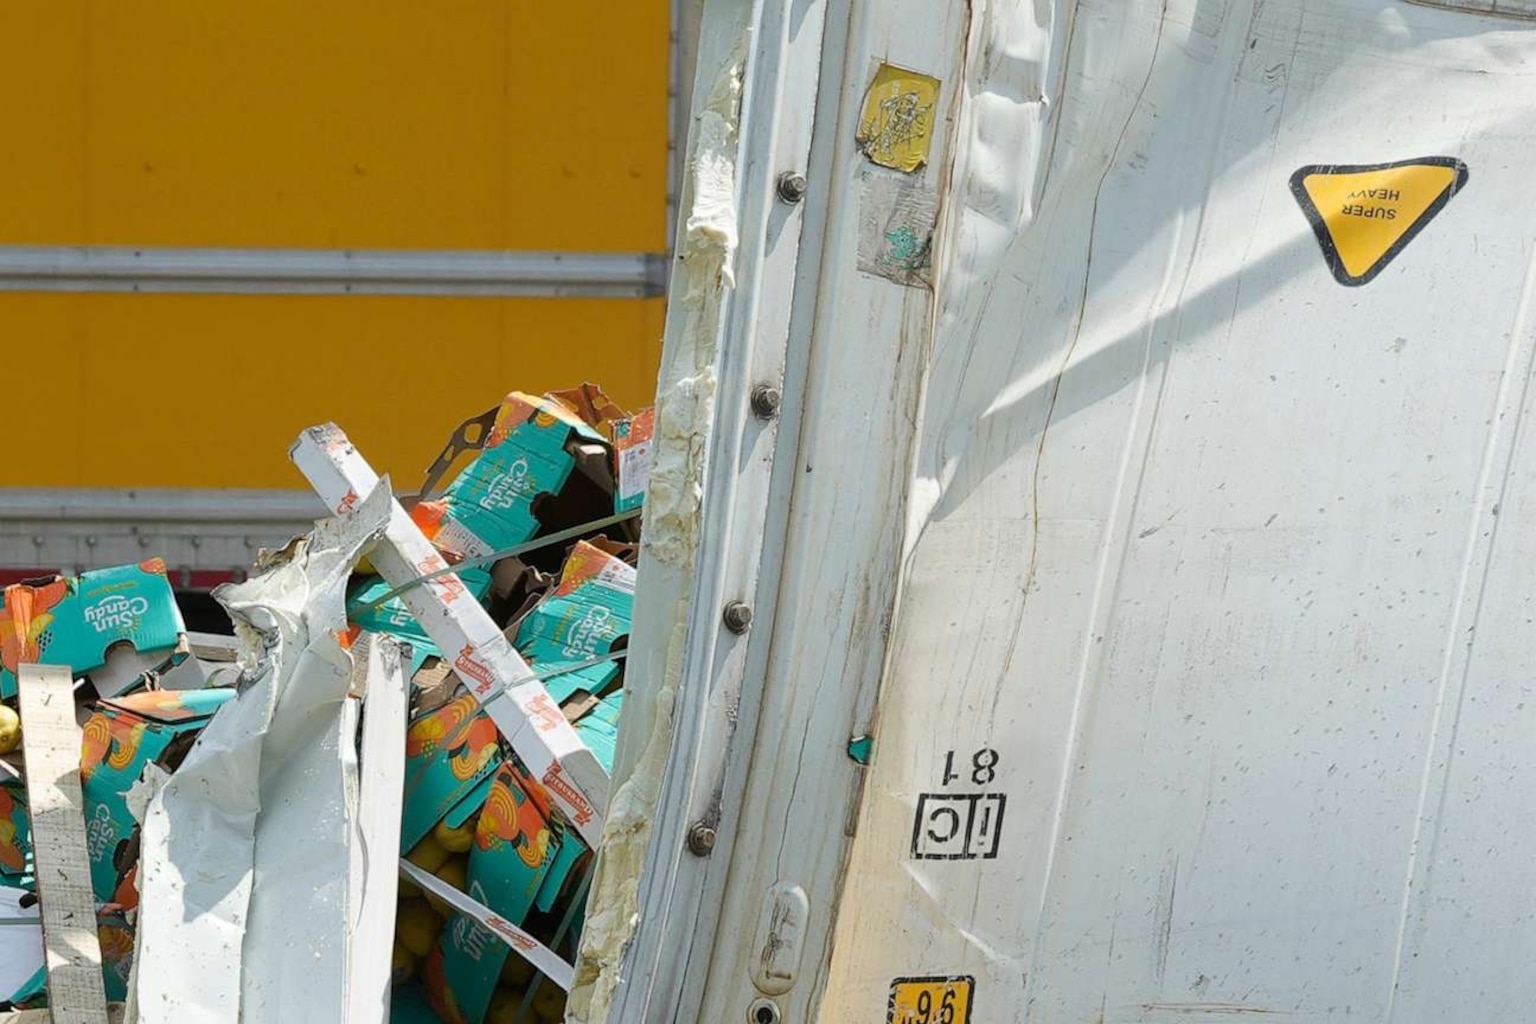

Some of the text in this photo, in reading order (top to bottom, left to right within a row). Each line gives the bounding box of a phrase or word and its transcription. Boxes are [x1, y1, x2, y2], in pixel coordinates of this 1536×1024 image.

[1347, 189, 1400, 201] HEAVY
[1342, 204, 1396, 219] SUPER
[84, 596, 149, 623] Candy
[93, 611, 133, 633] Sun
[942, 748, 1000, 786] 81
